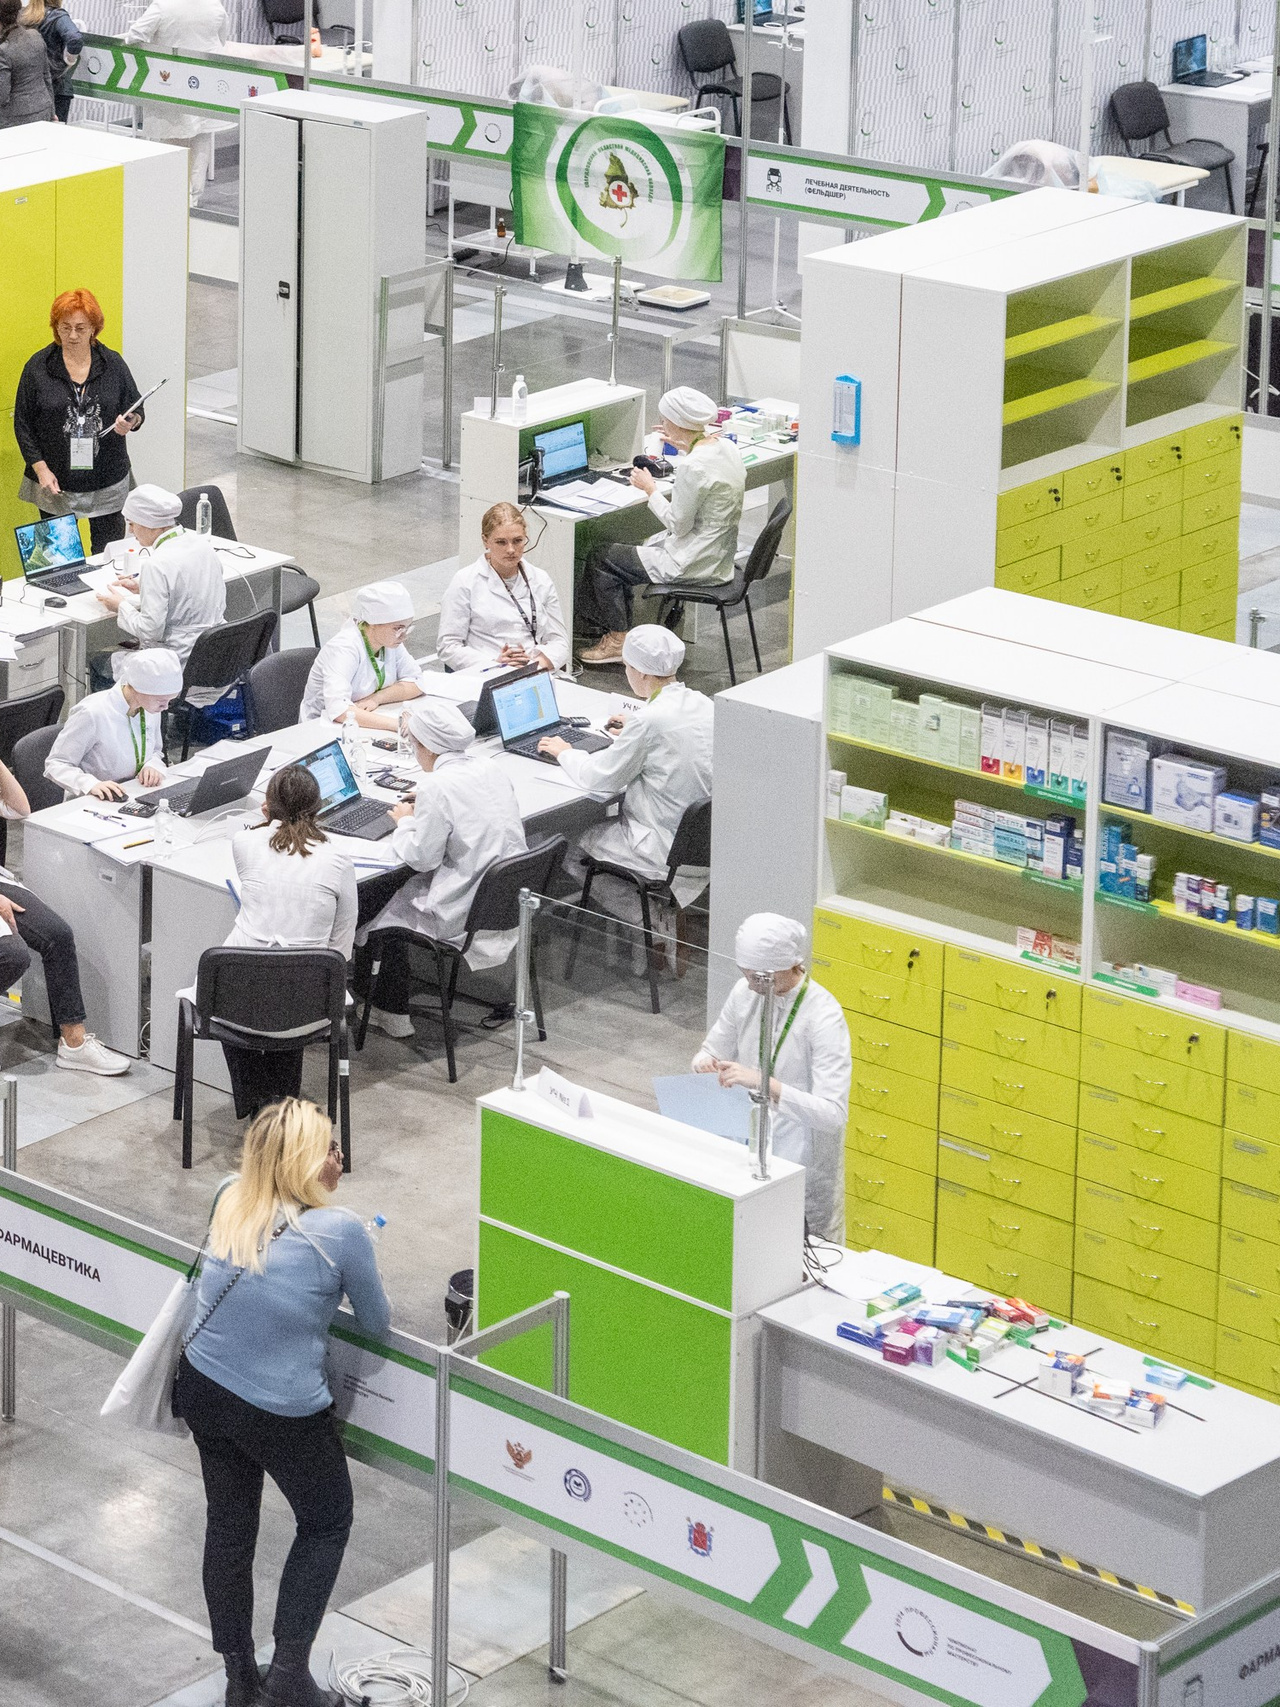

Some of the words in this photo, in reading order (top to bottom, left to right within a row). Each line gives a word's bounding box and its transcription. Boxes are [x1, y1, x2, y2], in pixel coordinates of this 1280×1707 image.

[804, 187, 846, 200] (ФЕЛЬДШЕР)
[805, 178, 838, 189] ЛЕЧЕБНАЯ
[839, 184, 890, 198] ДЕЯТЕЛЬНОСТЬ
